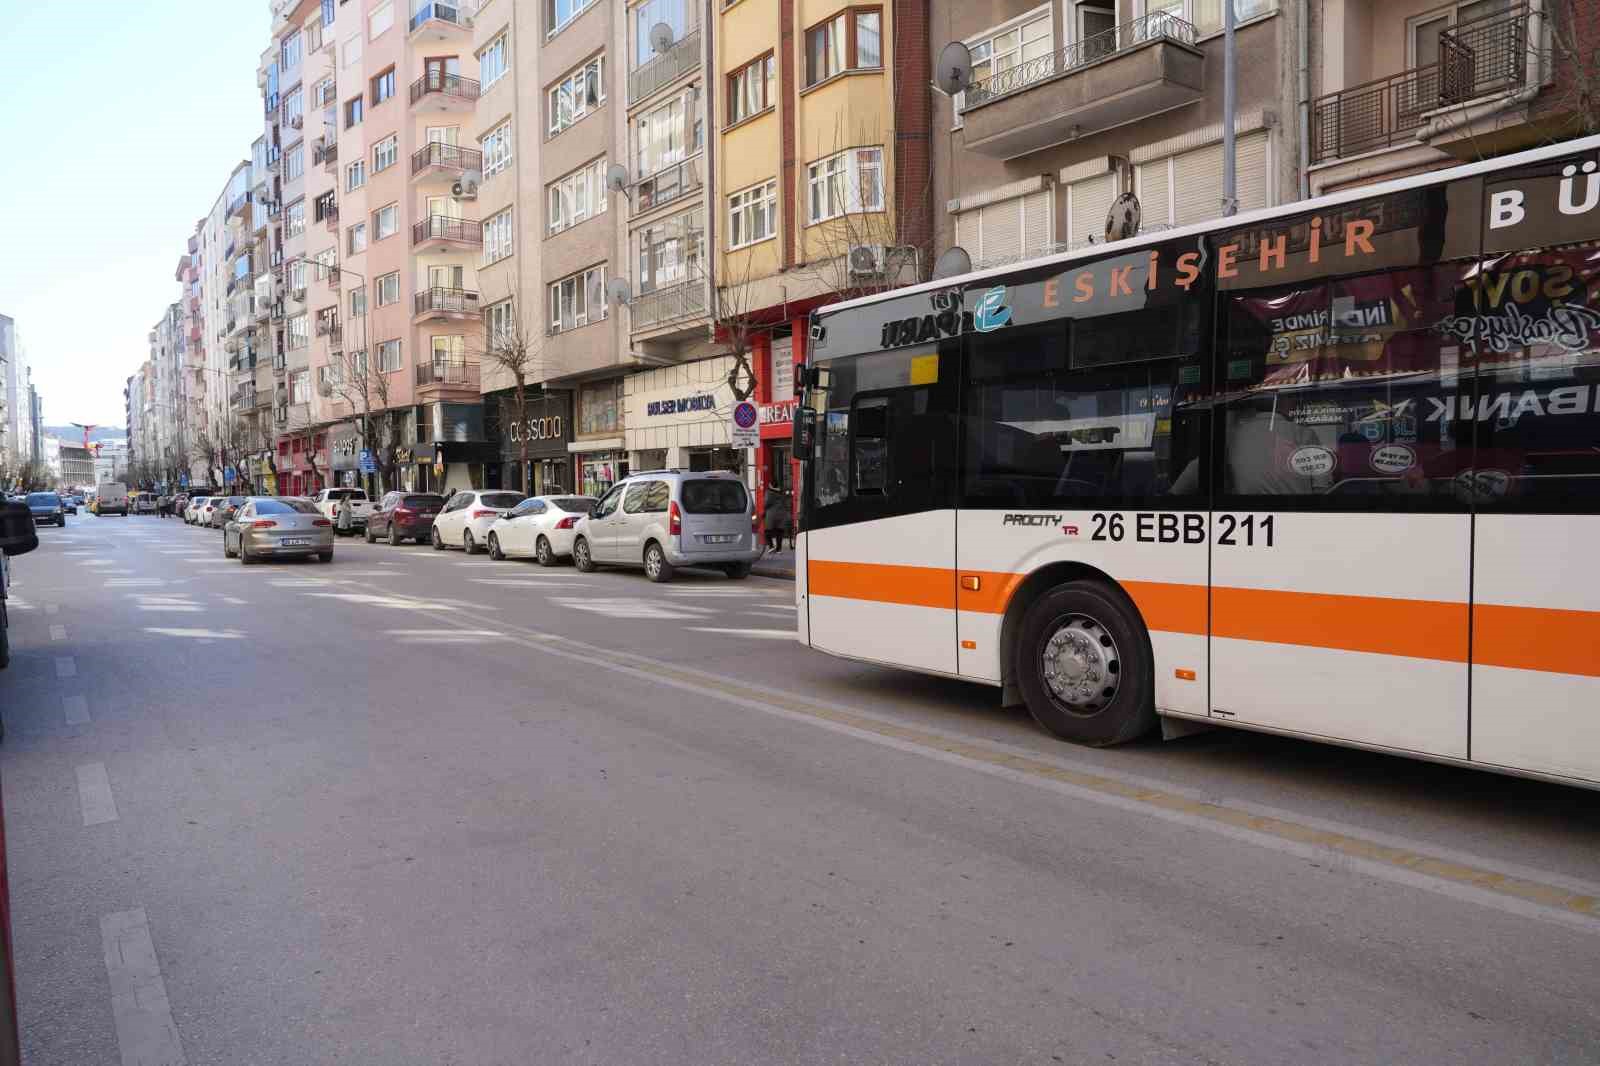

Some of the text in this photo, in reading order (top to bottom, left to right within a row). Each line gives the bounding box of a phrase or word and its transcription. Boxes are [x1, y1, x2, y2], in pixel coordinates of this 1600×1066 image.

[1043, 216, 1377, 309] ESKİŞEHİR
[1002, 513, 1062, 526] PROCITY
[1062, 526, 1079, 536] TR
[1091, 513, 1275, 547] 26 EBB 211
